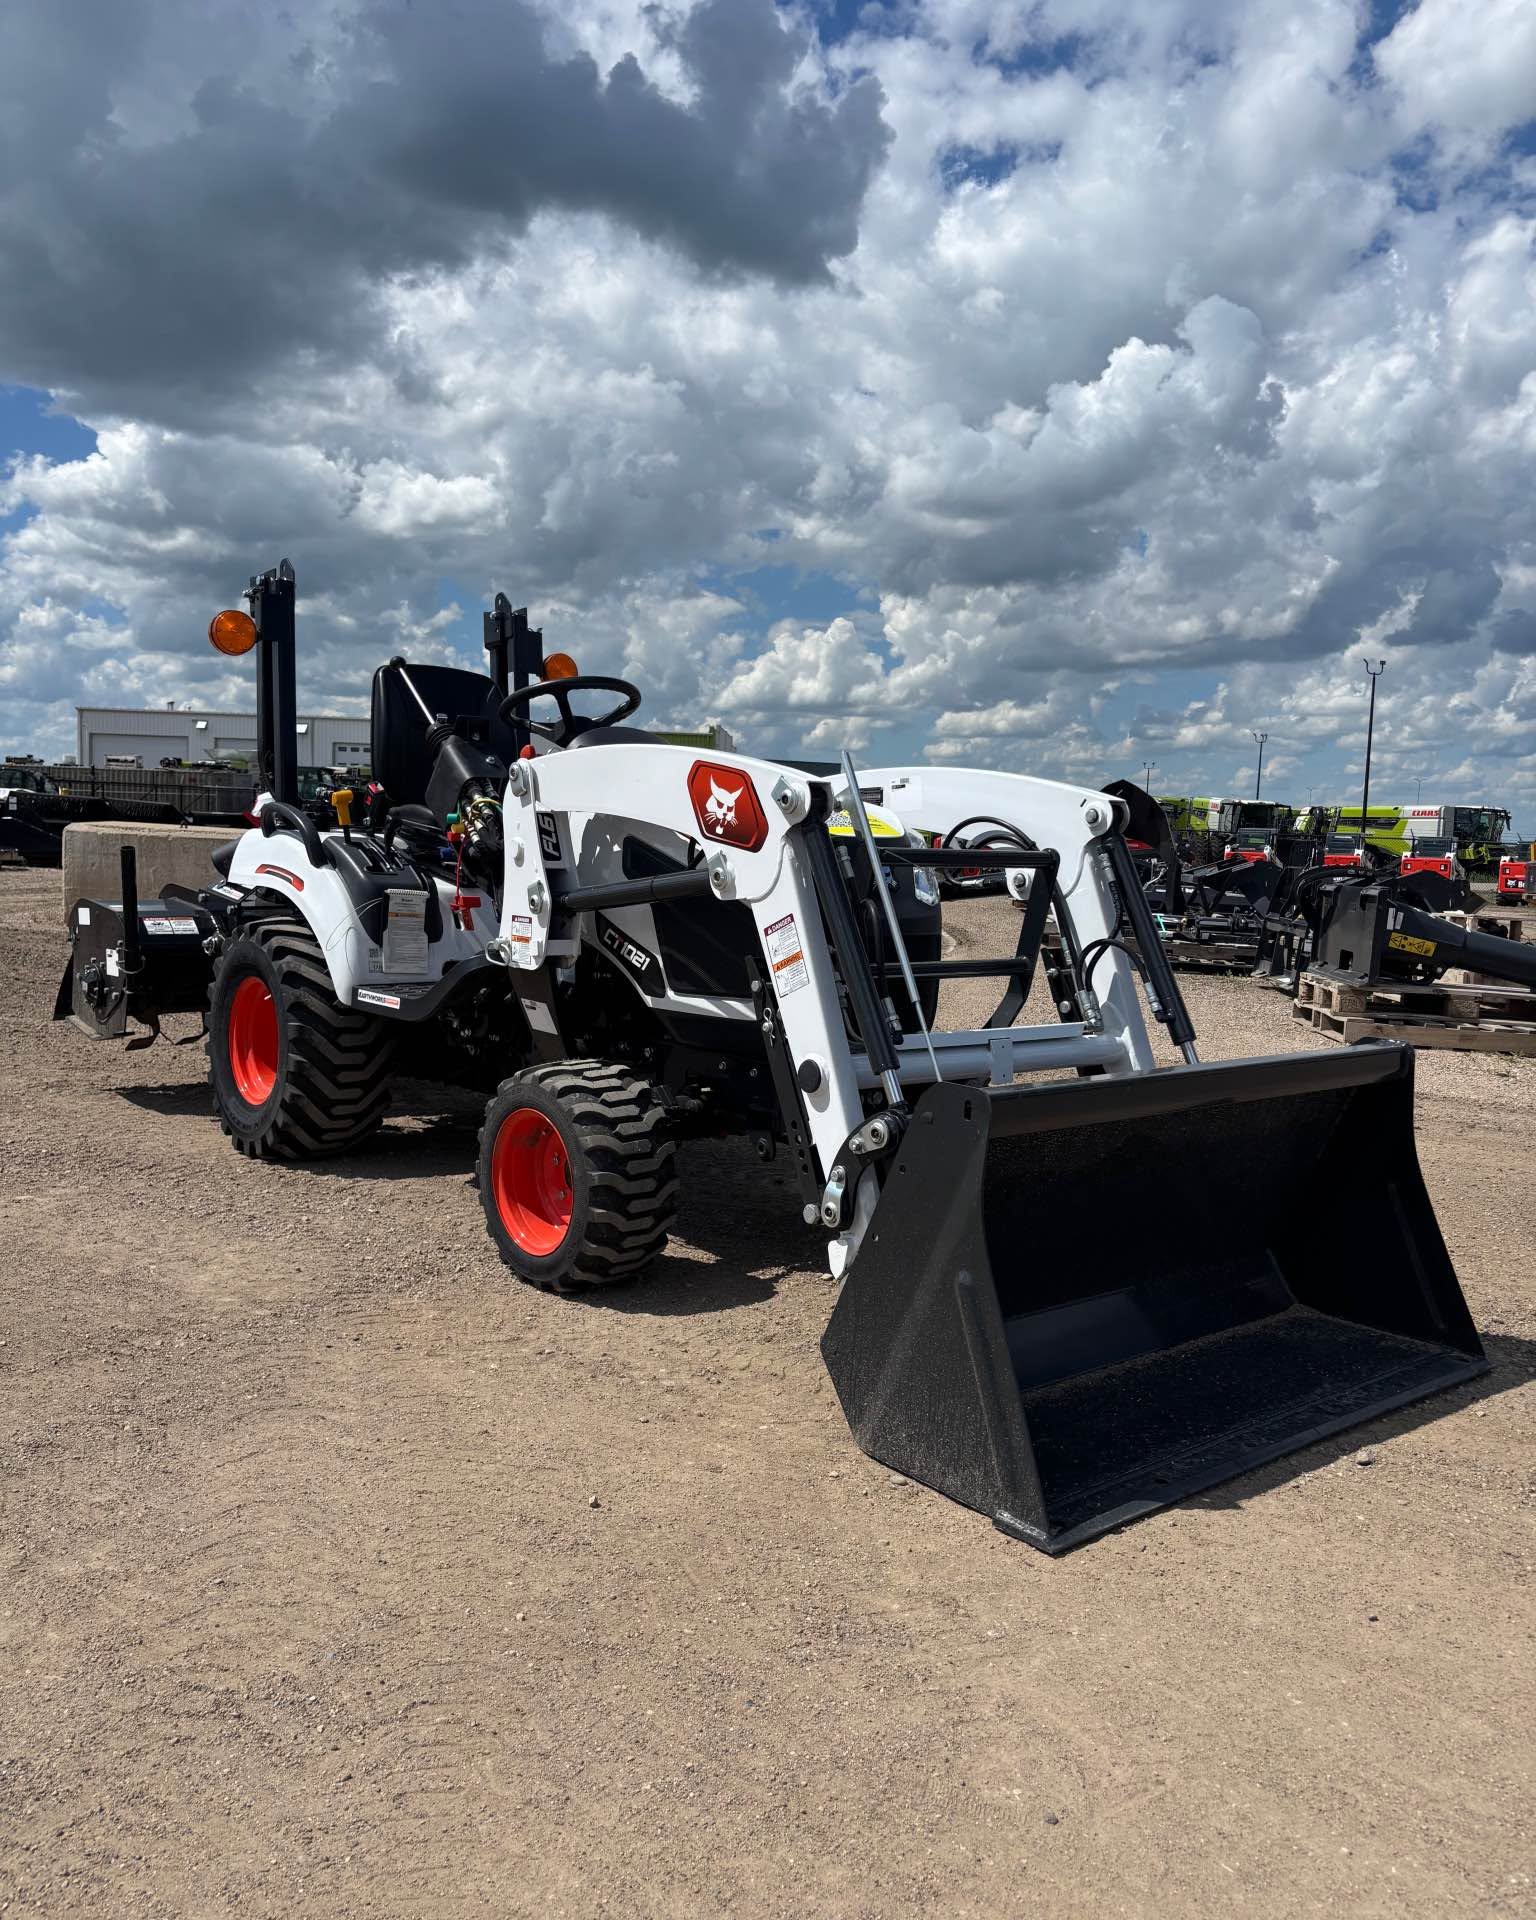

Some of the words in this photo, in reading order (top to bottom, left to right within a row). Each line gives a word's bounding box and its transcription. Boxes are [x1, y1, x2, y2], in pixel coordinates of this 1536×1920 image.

[538, 814, 560, 857] FL6
[771, 916, 792, 932] DANGER
[604, 929, 650, 971] CT1021
